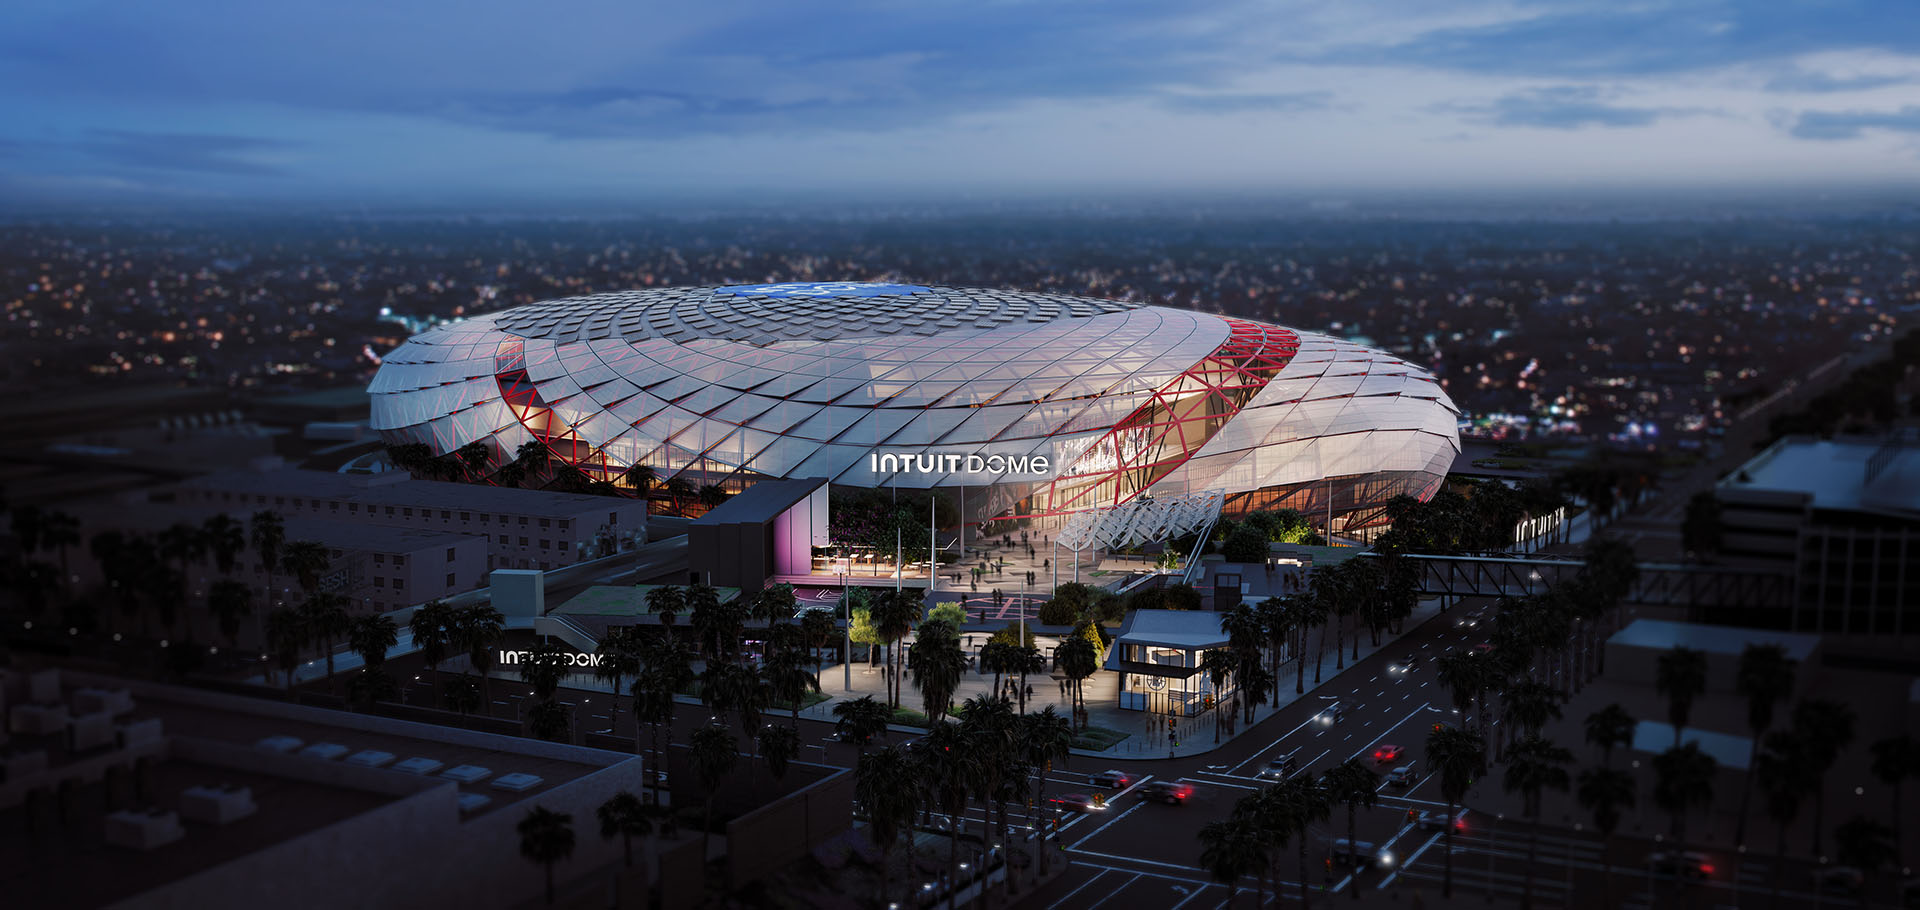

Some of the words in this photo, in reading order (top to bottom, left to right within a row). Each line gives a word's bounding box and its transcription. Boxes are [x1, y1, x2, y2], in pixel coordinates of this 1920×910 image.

[871, 453, 961, 473] INTUIT
[967, 454, 1049, 474] DOME
[563, 652, 616, 668] DOM
